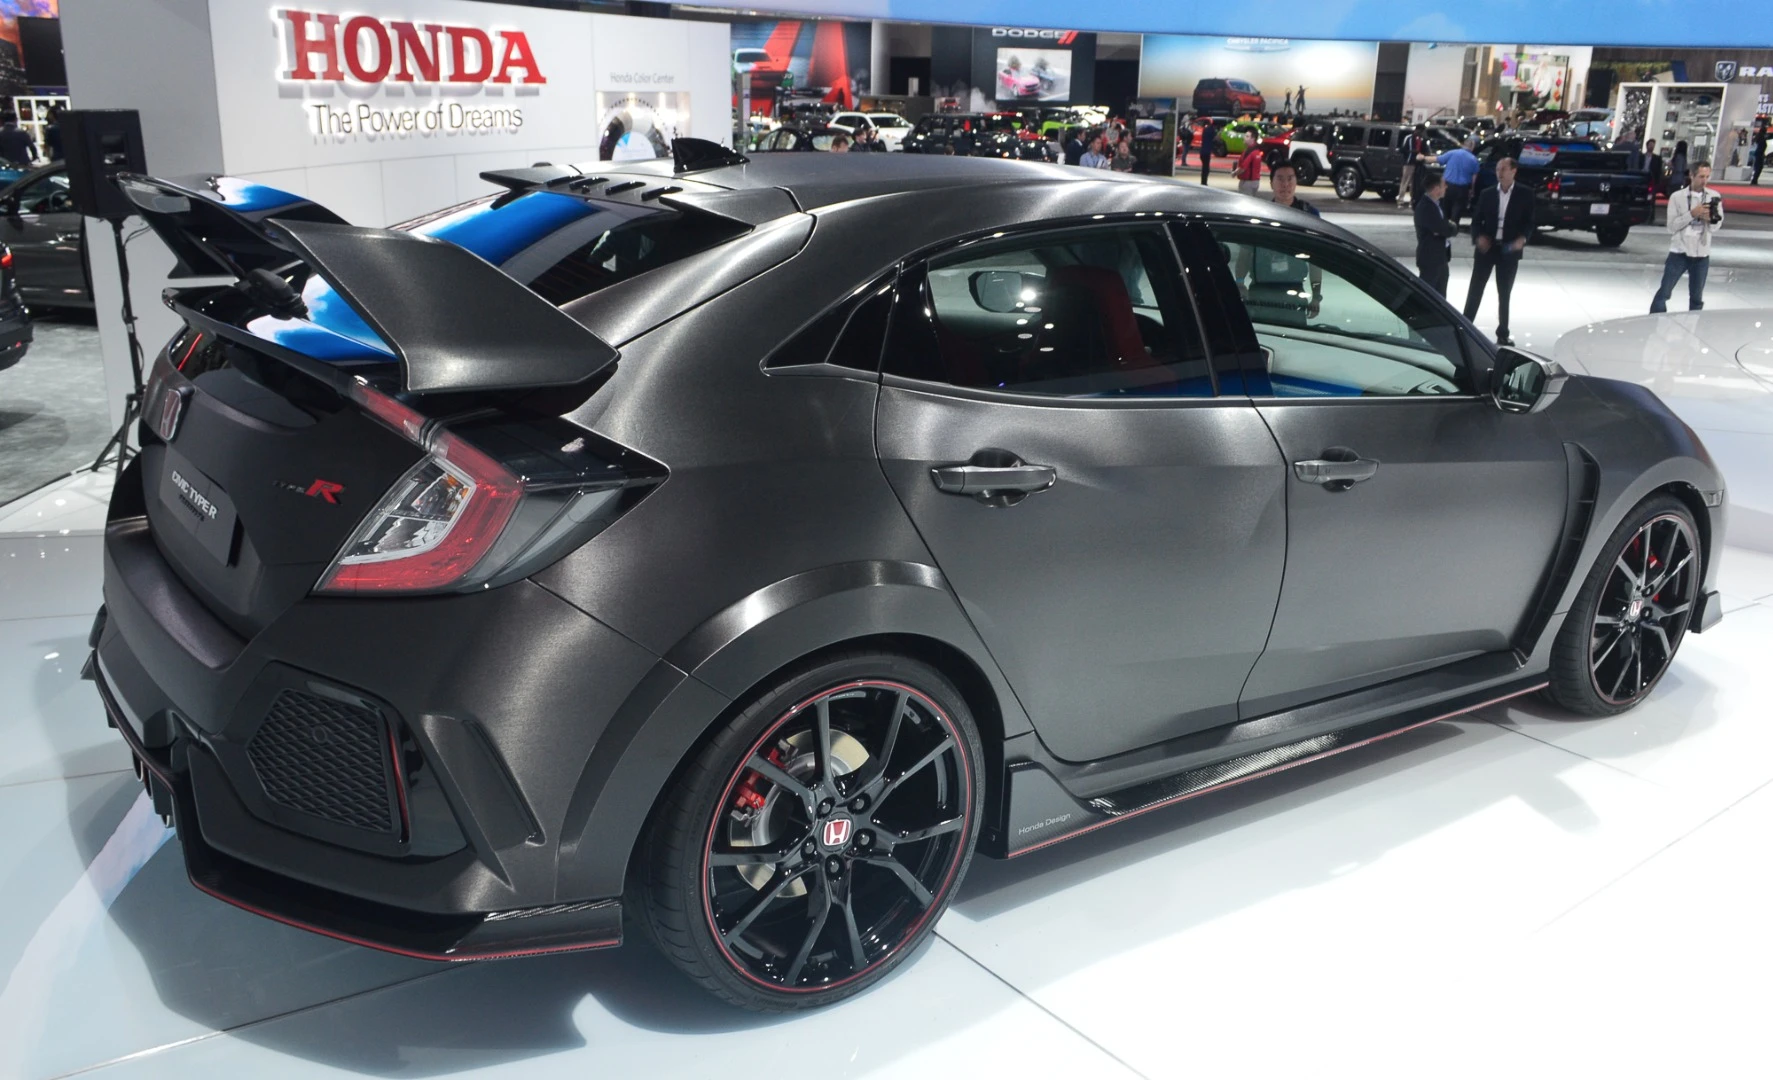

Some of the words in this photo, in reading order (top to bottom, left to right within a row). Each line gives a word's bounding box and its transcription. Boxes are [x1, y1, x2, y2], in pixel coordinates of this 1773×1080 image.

[280, 10, 546, 84] HONDA
[610, 72, 632, 83] Honda
[311, 104, 351, 134] The
[357, 104, 419, 132] Power
[425, 103, 444, 129] of
[450, 103, 523, 128] Dreams
[171, 470, 190, 493] CIVIC
[189, 486, 210, 513] TYPE
[208, 504, 218, 519] R
[305, 479, 344, 505] R
[1018, 822, 1044, 835] Honda
[1045, 813, 1071, 826] Design
